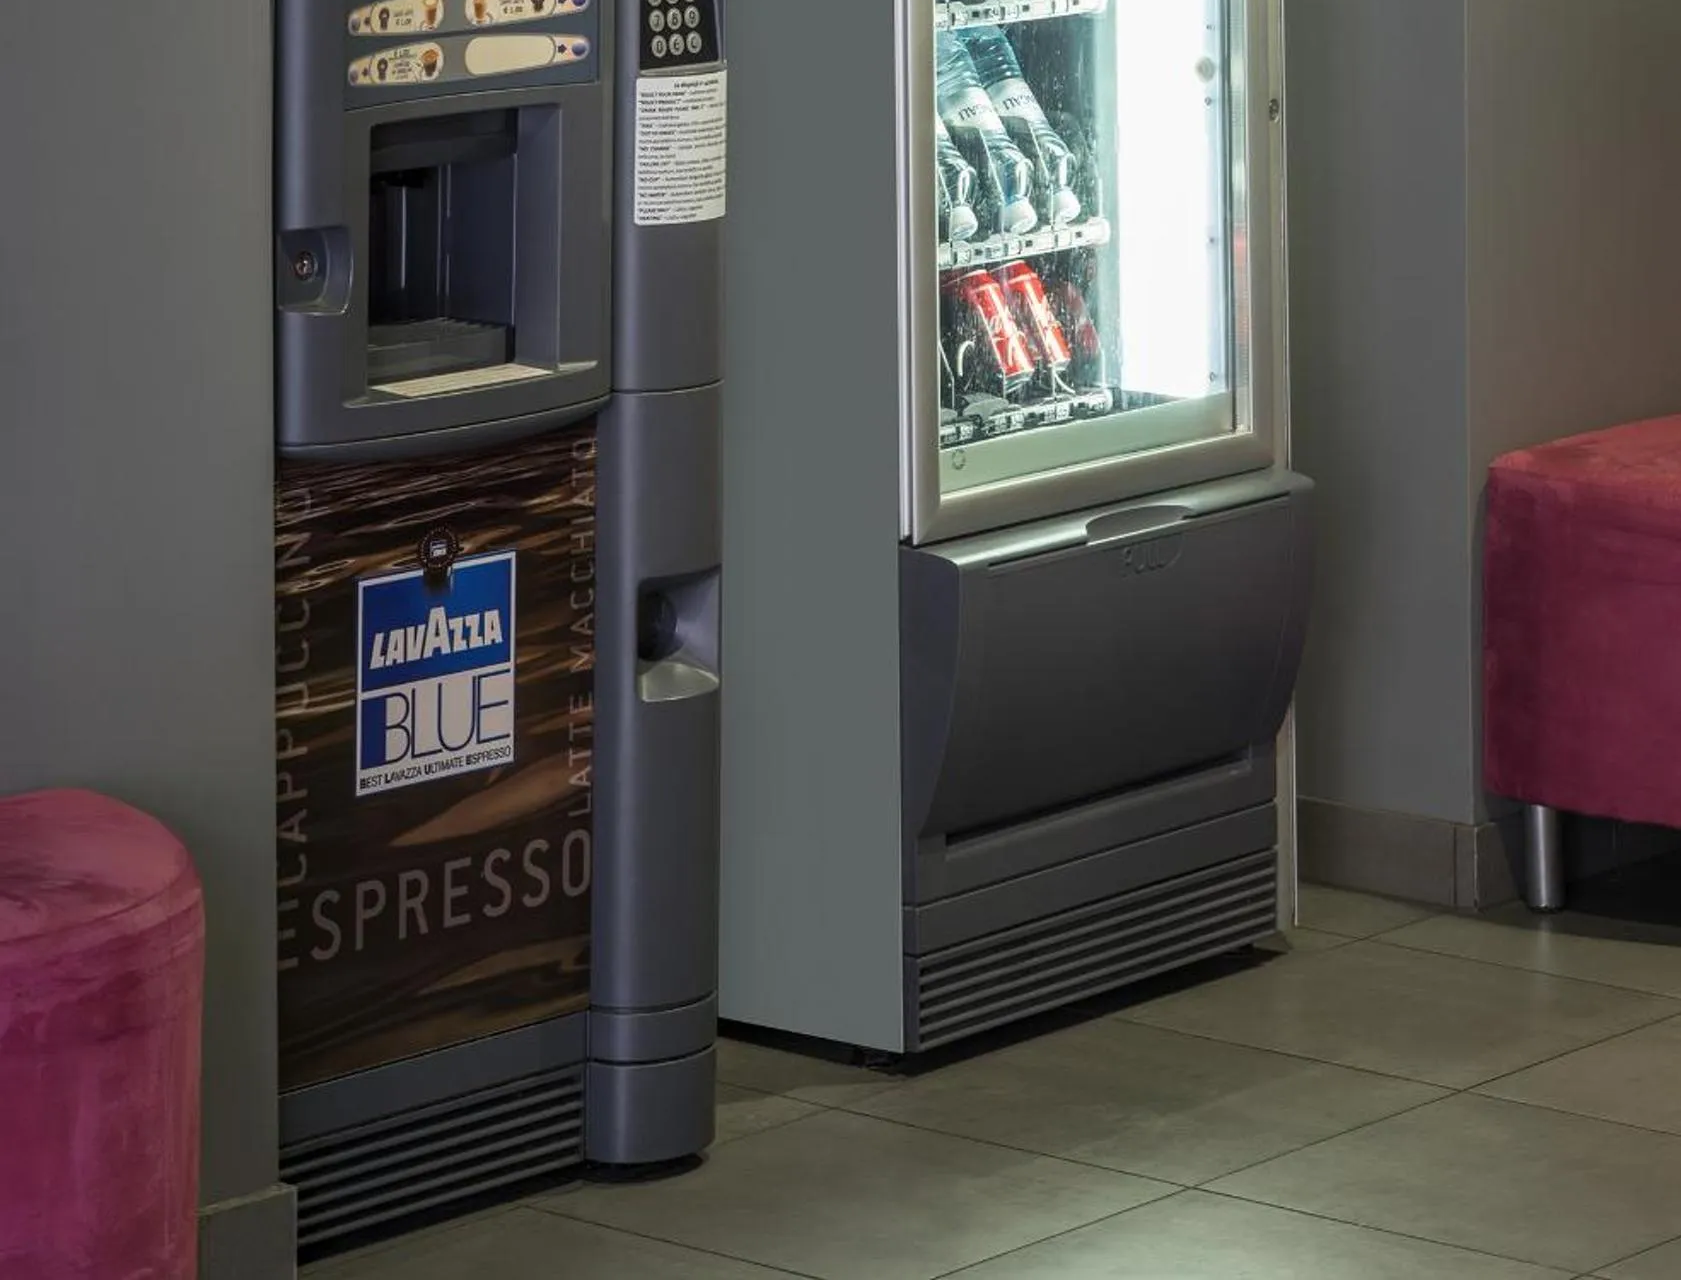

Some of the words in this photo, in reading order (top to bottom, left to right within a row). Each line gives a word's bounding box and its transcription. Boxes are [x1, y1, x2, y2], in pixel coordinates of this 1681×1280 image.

[569, 436, 597, 673] MACCHIATO
[369, 606, 503, 671] LAVAZZA
[360, 774, 384, 790] BEST
[424, 755, 465, 775] ULTIMATE
[465, 746, 512, 766] ESPRESSO
[361, 667, 511, 771] BLUE
[569, 693, 594, 816] LATTE
